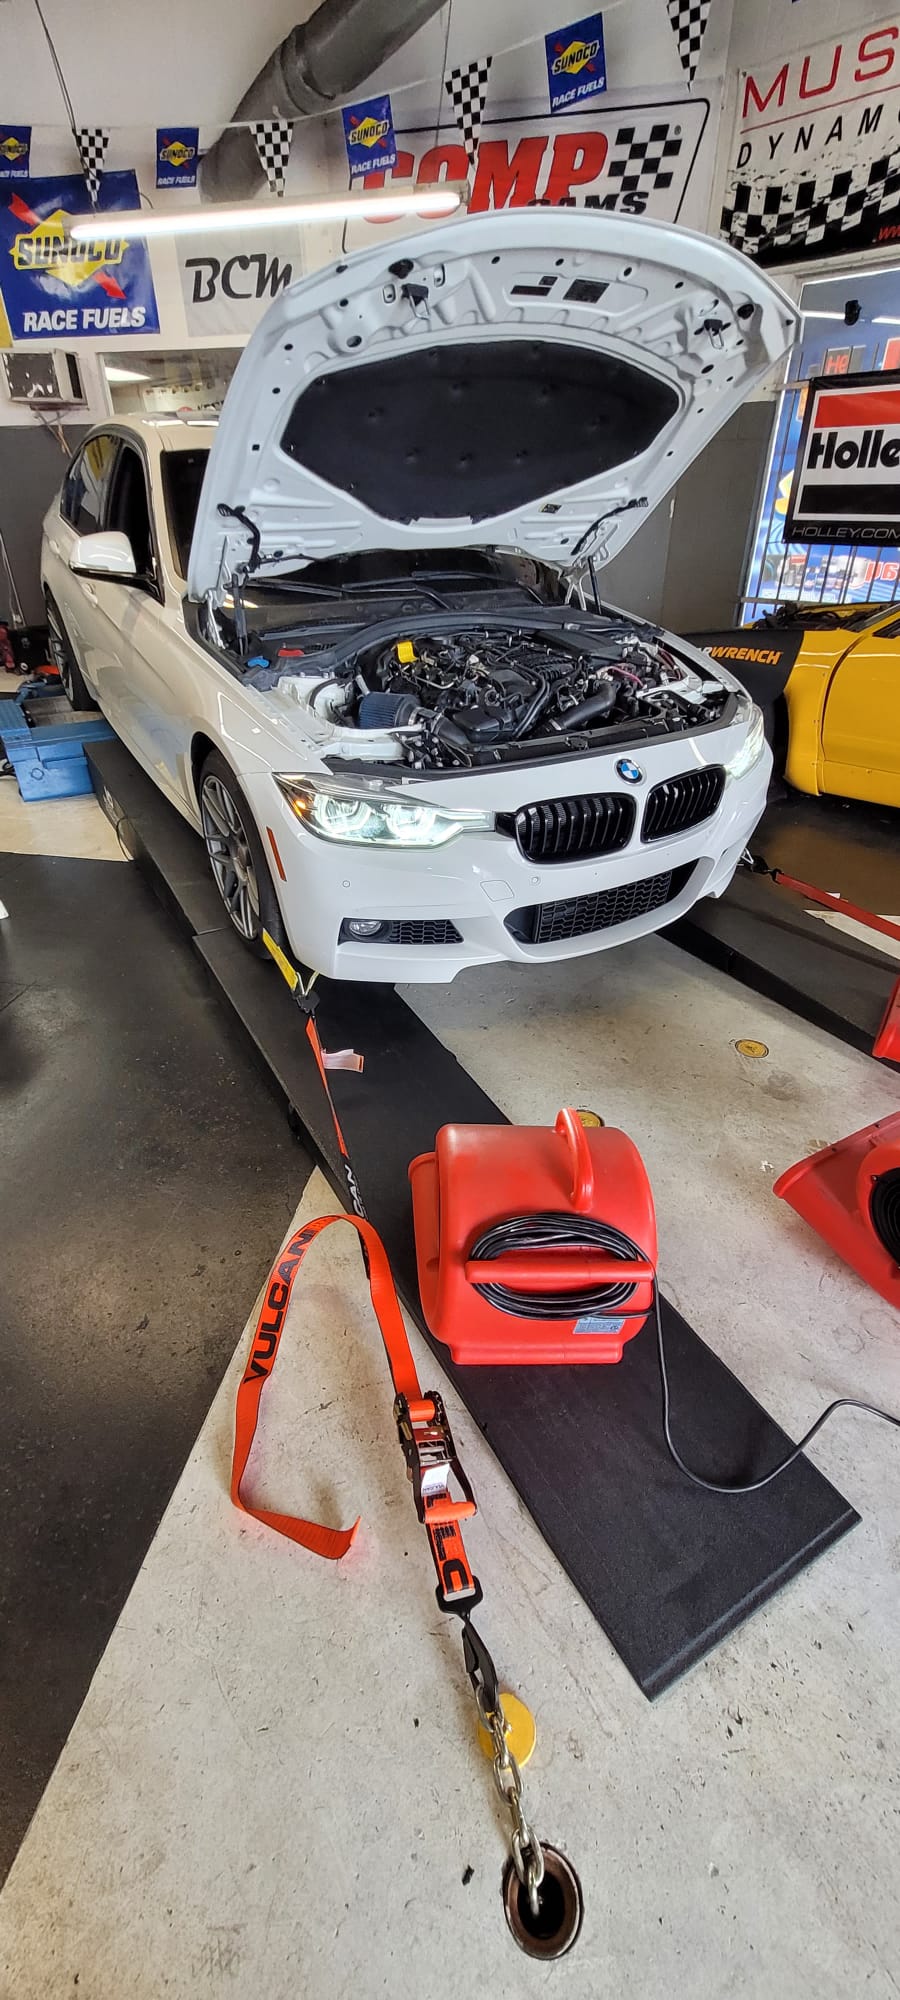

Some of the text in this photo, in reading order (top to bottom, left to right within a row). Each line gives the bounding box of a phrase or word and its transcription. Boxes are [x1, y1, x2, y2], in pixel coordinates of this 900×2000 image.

[553, 42, 598, 74] SUNOCO
[742, 26, 899, 118] MUS
[552, 77, 605, 108] RACE FUELS
[350, 122, 389, 144] SUNOCO
[736, 104, 900, 169] DYNAM
[351, 153, 397, 175] RACE FUELS
[17, 235, 121, 267] SUNOCO
[184, 253, 293, 304] BCM
[23, 306, 147, 333] RACE FUELS
[697, 646, 782, 666] RWRENCH
[243, 1228, 316, 1385] VULCAN
